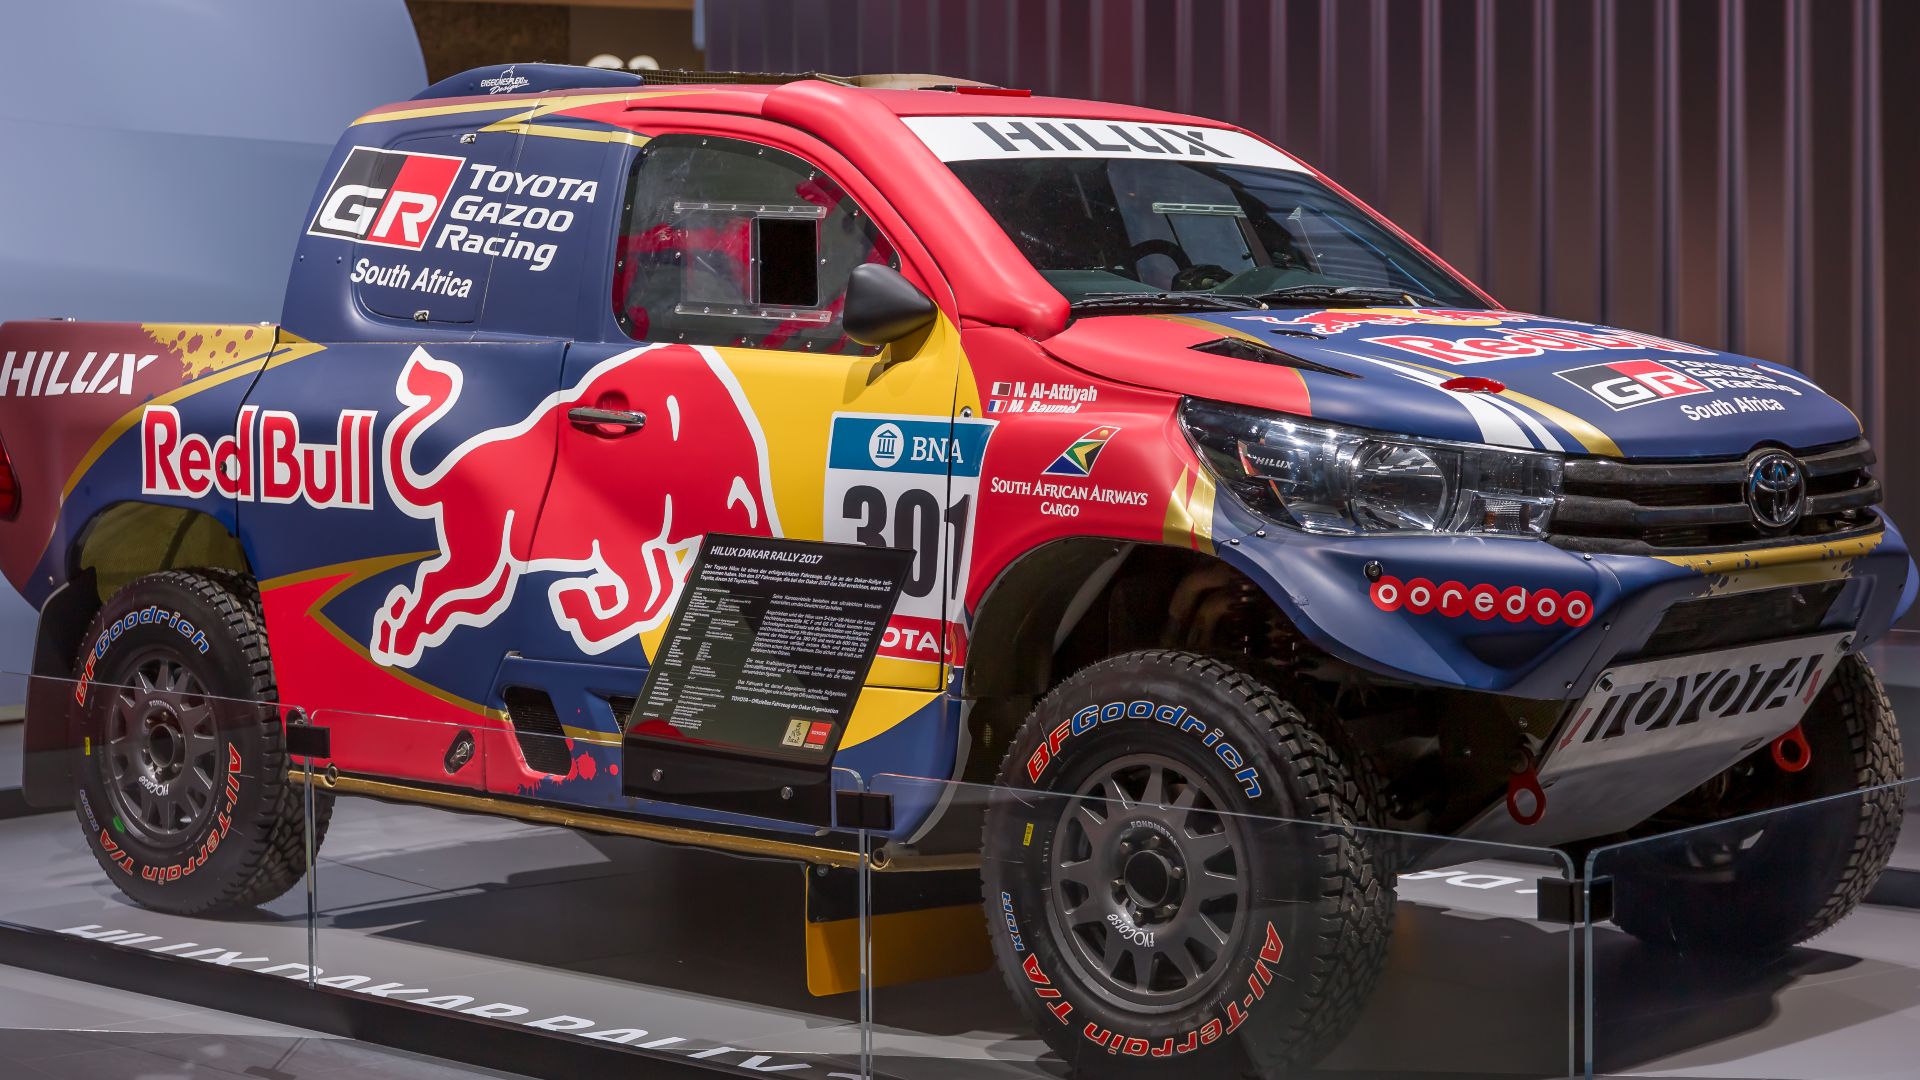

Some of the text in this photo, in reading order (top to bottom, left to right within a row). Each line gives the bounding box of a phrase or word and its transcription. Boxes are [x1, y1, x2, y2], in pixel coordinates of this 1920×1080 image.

[973, 121, 1234, 158] HILUX
[470, 163, 598, 203] TOYOTA
[319, 184, 438, 243] GR
[450, 195, 574, 232] GAZOO
[435, 223, 558, 272] Racing
[350, 257, 473, 298] South Africa
[0, 351, 158, 396] HILUX
[1658, 359, 1764, 375] TOYOTA
[1685, 368, 1777, 383] GAZOO
[1014, 381, 1098, 404] N. Al-Attiyah
[1591, 371, 1703, 405] GR
[1704, 377, 1802, 395] Racing
[1007, 400, 1082, 414] M. Baumel
[1680, 397, 1785, 421] South Africa
[910, 436, 964, 464] BNA
[1256, 456, 1294, 470] HILUX
[990, 476, 1148, 506] SOUTH AFRICAN AIRWAYS
[1040, 501, 1079, 517] CARGO
[710, 546, 823, 564] HILUX DAKAR RALLY 2017
[842, 484, 971, 601] 301
[1377, 583, 1587, 619] ooredoo
[75, 605, 210, 707] BFGoodrich
[880, 626, 951, 656] OTAL
[1597, 654, 1824, 741] TOYOTA
[1026, 700, 1263, 798] BFGoodrich
